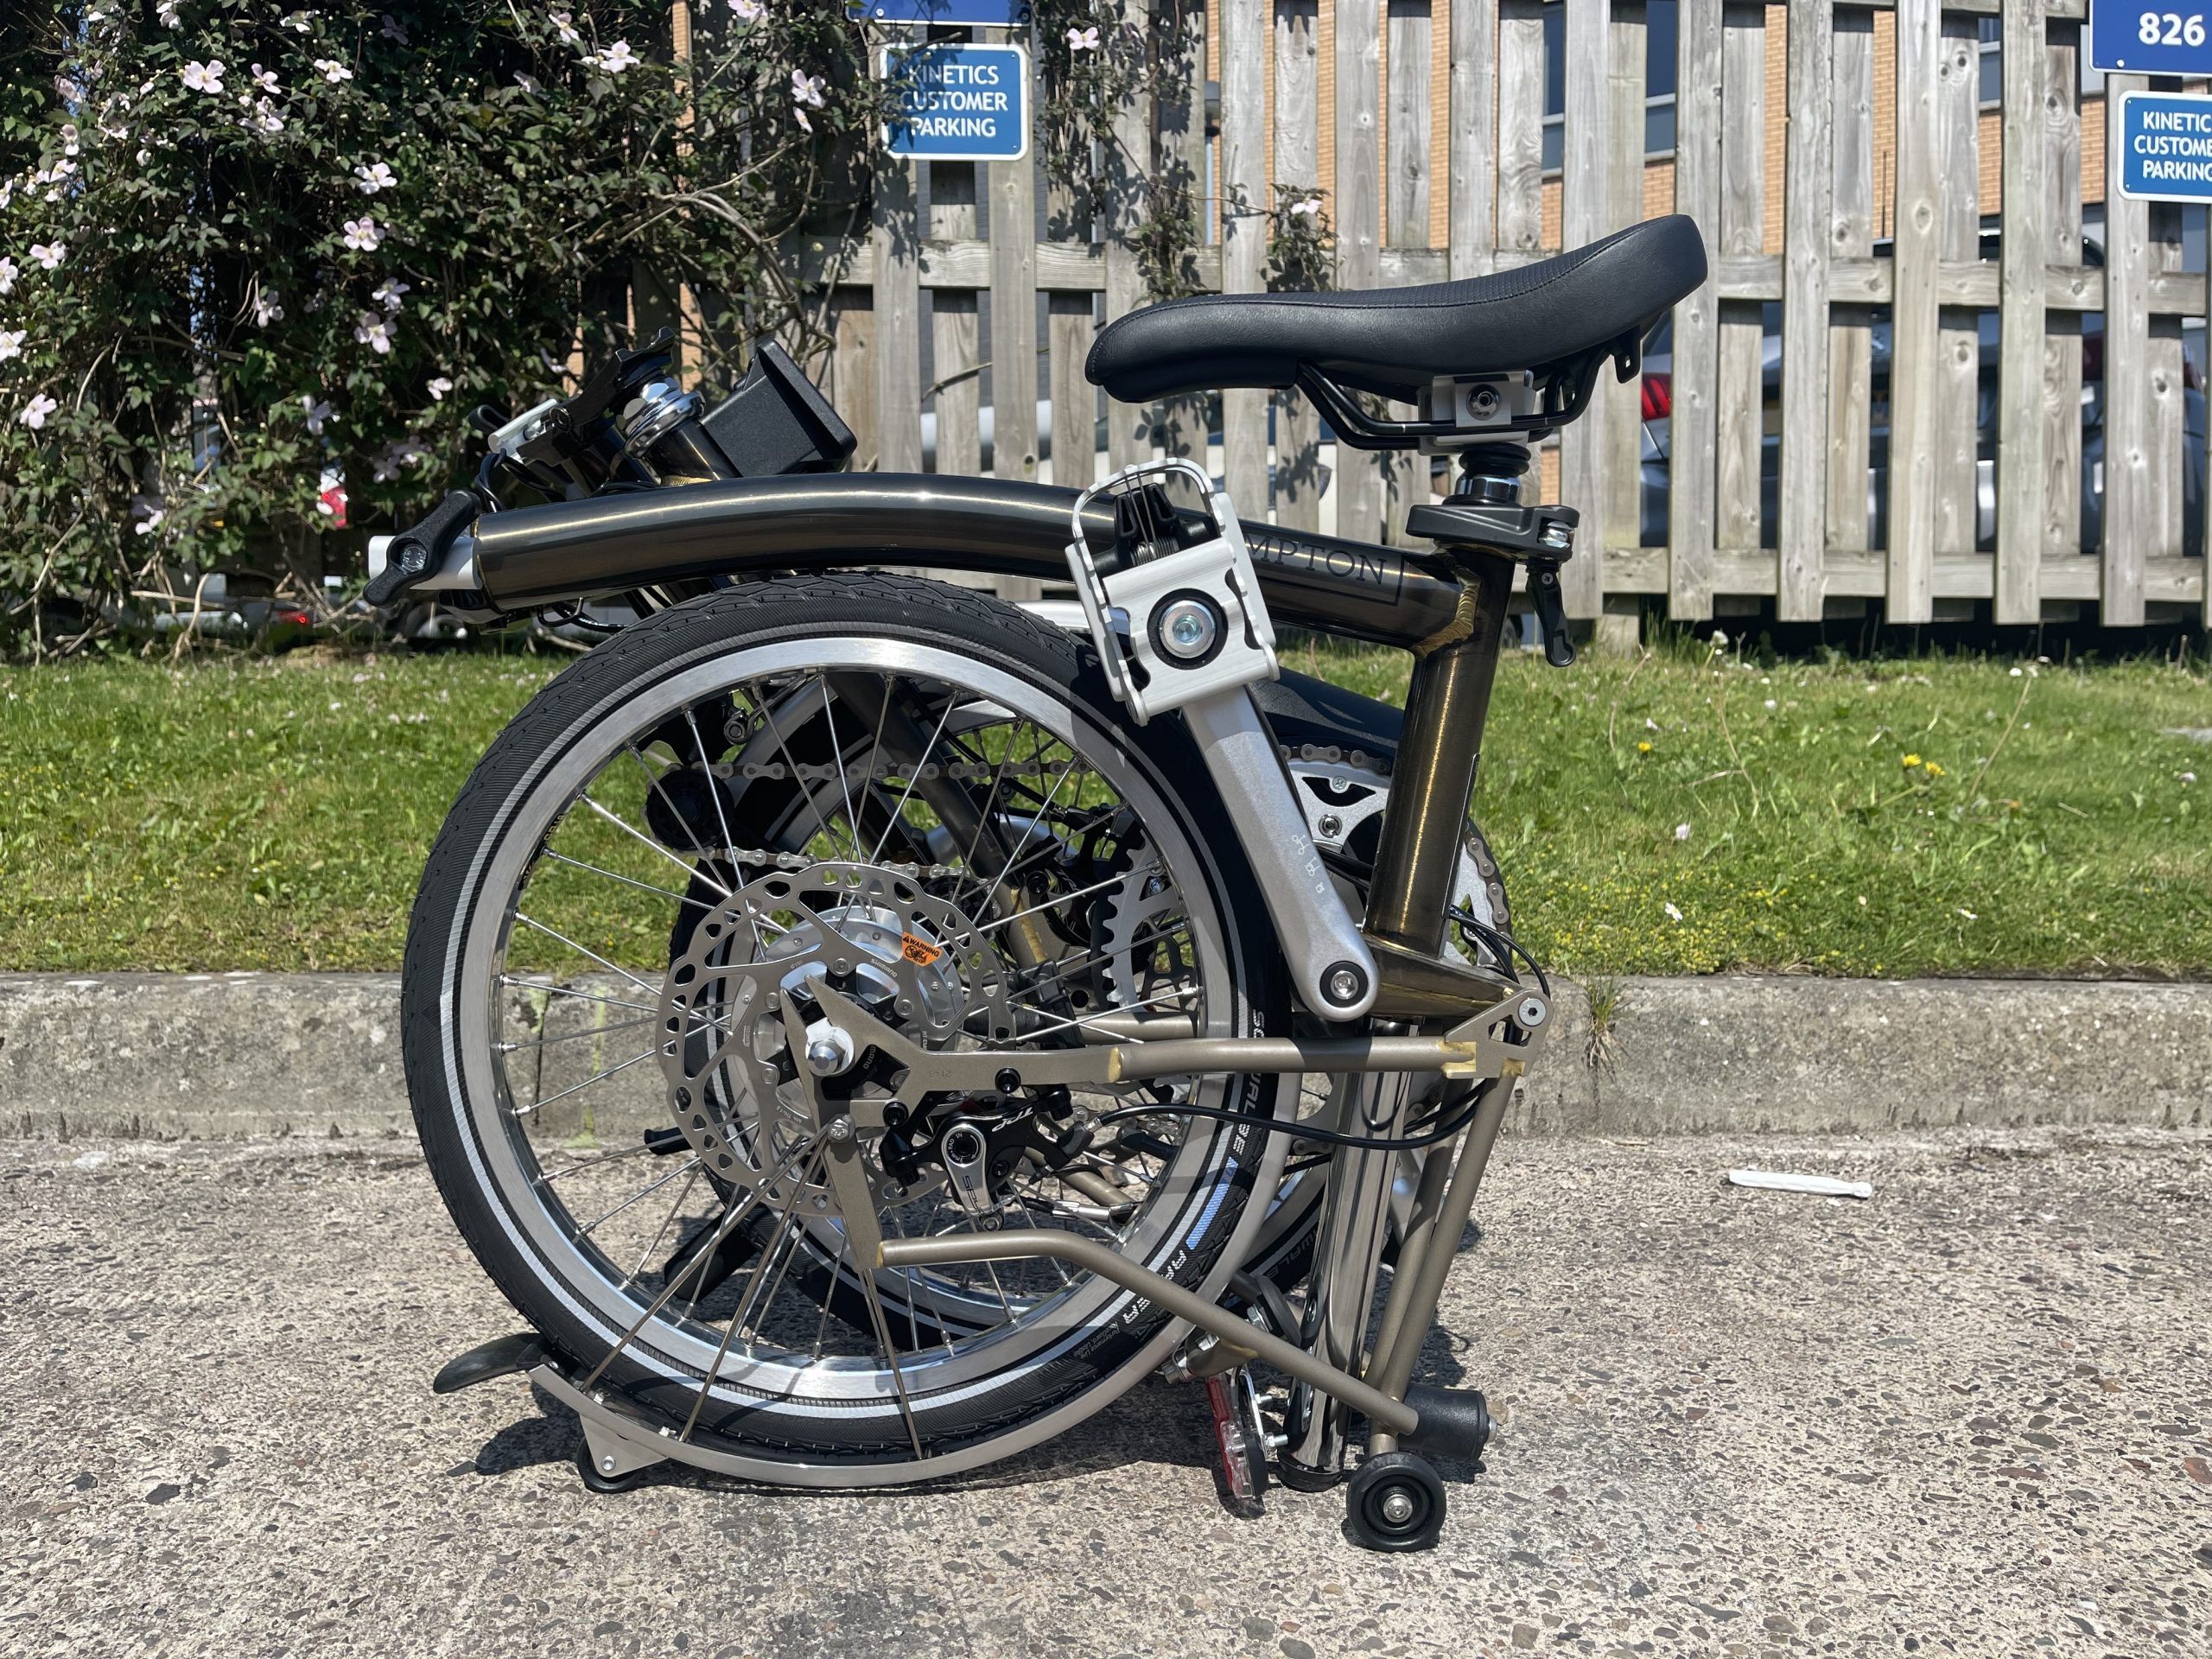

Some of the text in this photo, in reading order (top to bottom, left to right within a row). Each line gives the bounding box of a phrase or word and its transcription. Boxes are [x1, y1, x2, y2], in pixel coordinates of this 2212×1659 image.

[2139, 12, 2206, 47] 826
[908, 65, 1000, 85] KINETICS
[900, 92, 1008, 111] CUSTOMER
[910, 118, 996, 137] PARKING
[2143, 111, 2212, 133] KINETIC
[2133, 135, 2212, 157] CUSTOME
[1243, 533, 1387, 585] MPTON
[910, 938, 940, 957] WARNING
[870, 958, 898, 978] SHIMANO
[991, 1107, 1033, 1133] TRP
